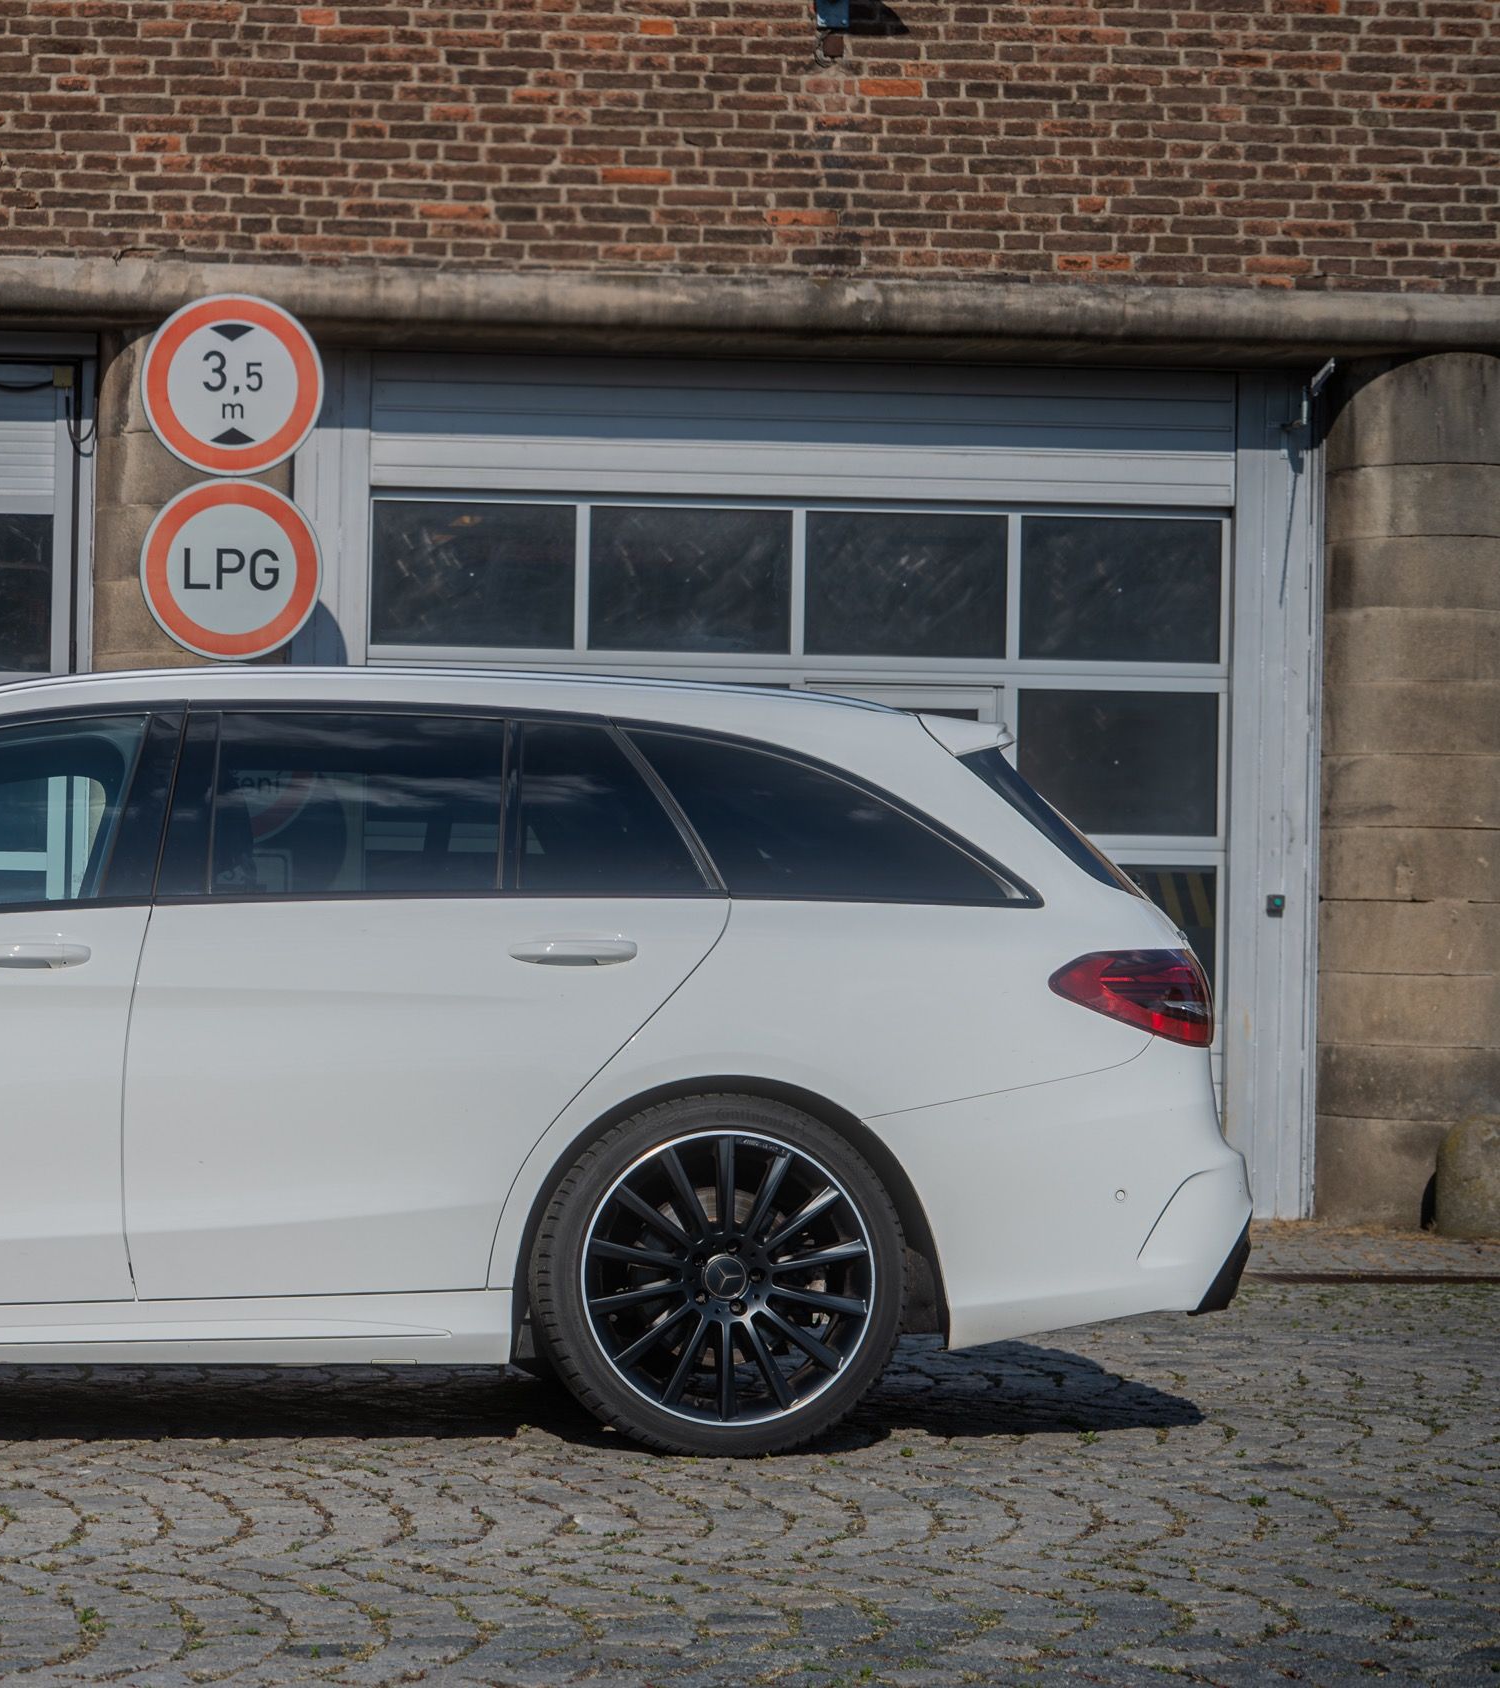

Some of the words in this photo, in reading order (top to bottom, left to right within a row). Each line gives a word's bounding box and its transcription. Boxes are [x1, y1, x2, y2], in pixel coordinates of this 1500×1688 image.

[202, 350, 263, 395] 3,5
[221, 403, 244, 419] m
[183, 547, 280, 591] LPG
